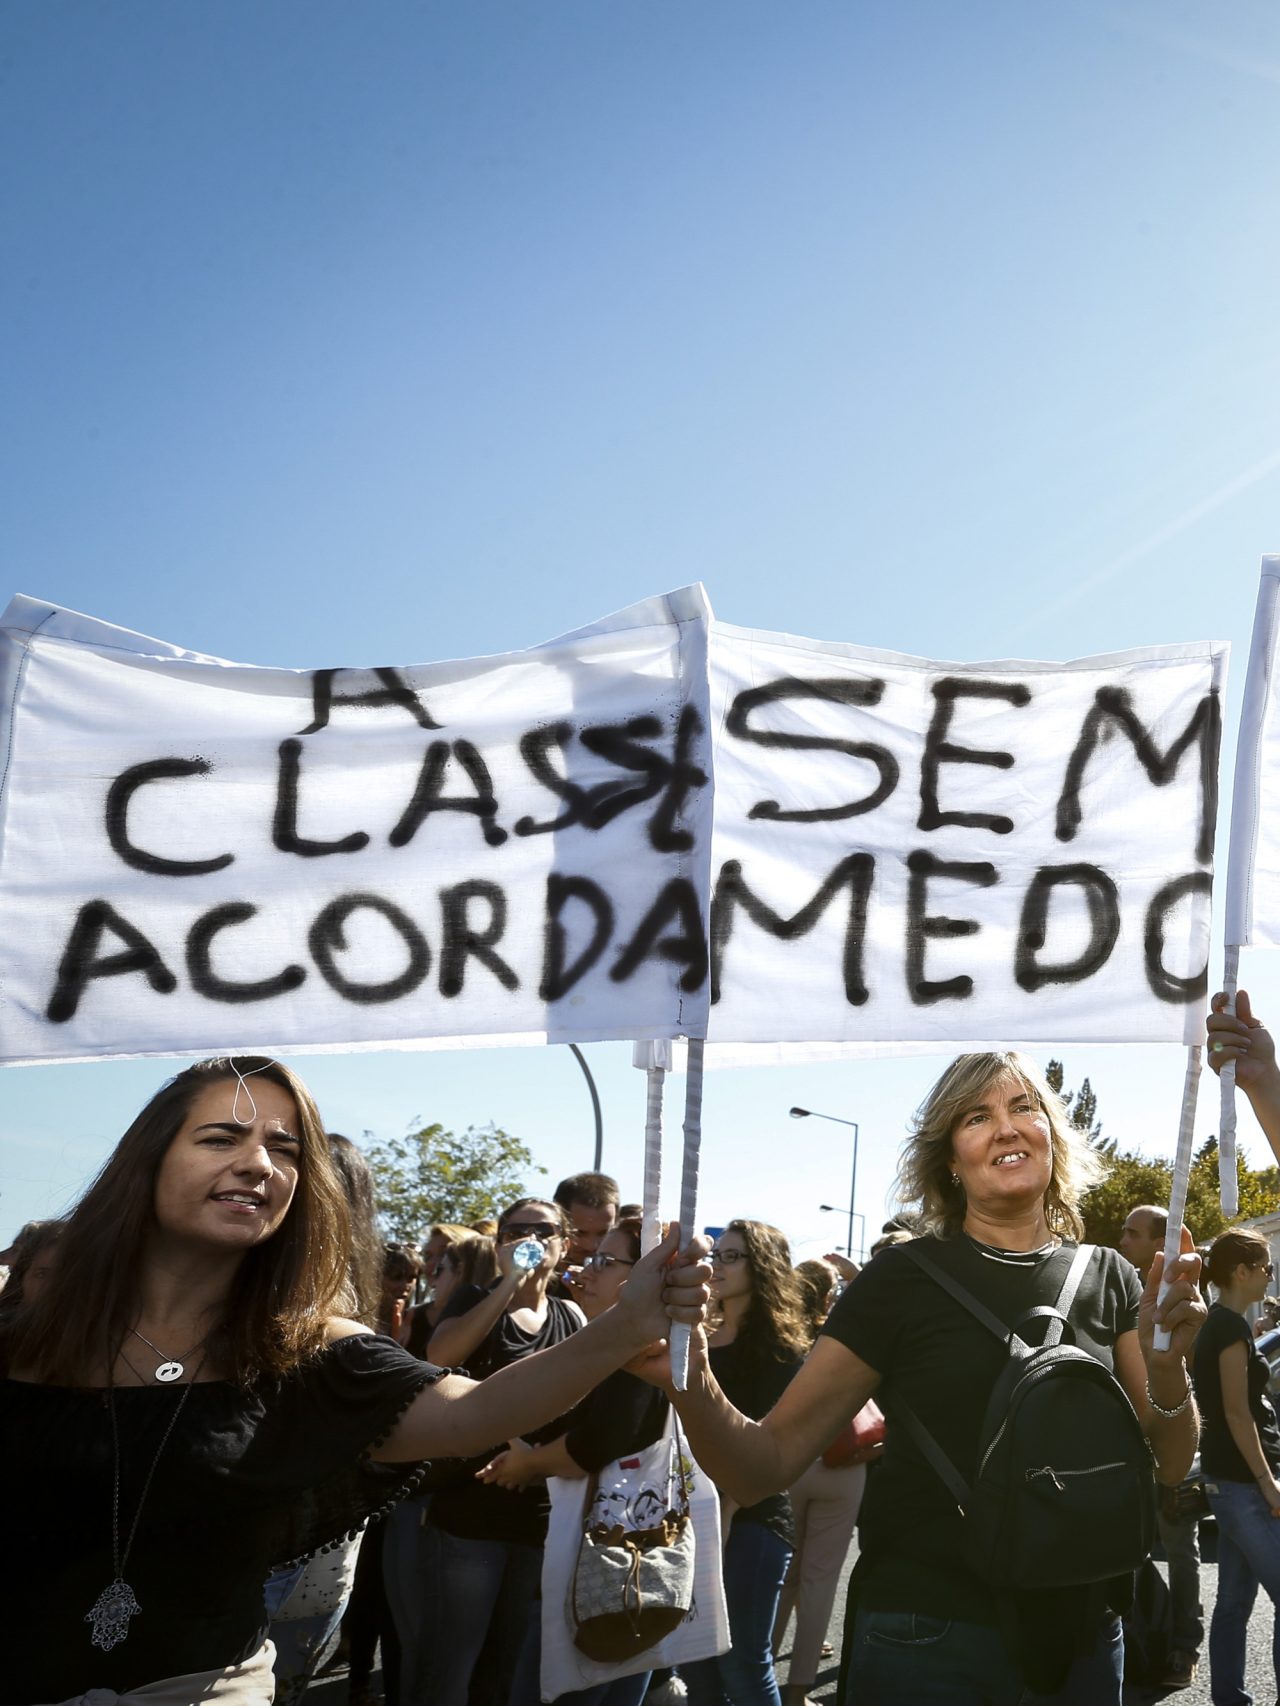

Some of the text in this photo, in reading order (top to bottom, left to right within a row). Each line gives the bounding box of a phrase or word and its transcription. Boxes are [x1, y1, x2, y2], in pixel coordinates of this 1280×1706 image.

[295, 667, 447, 734] A
[725, 675, 1221, 866] SEM
[46, 877, 709, 1022] ACORDA
